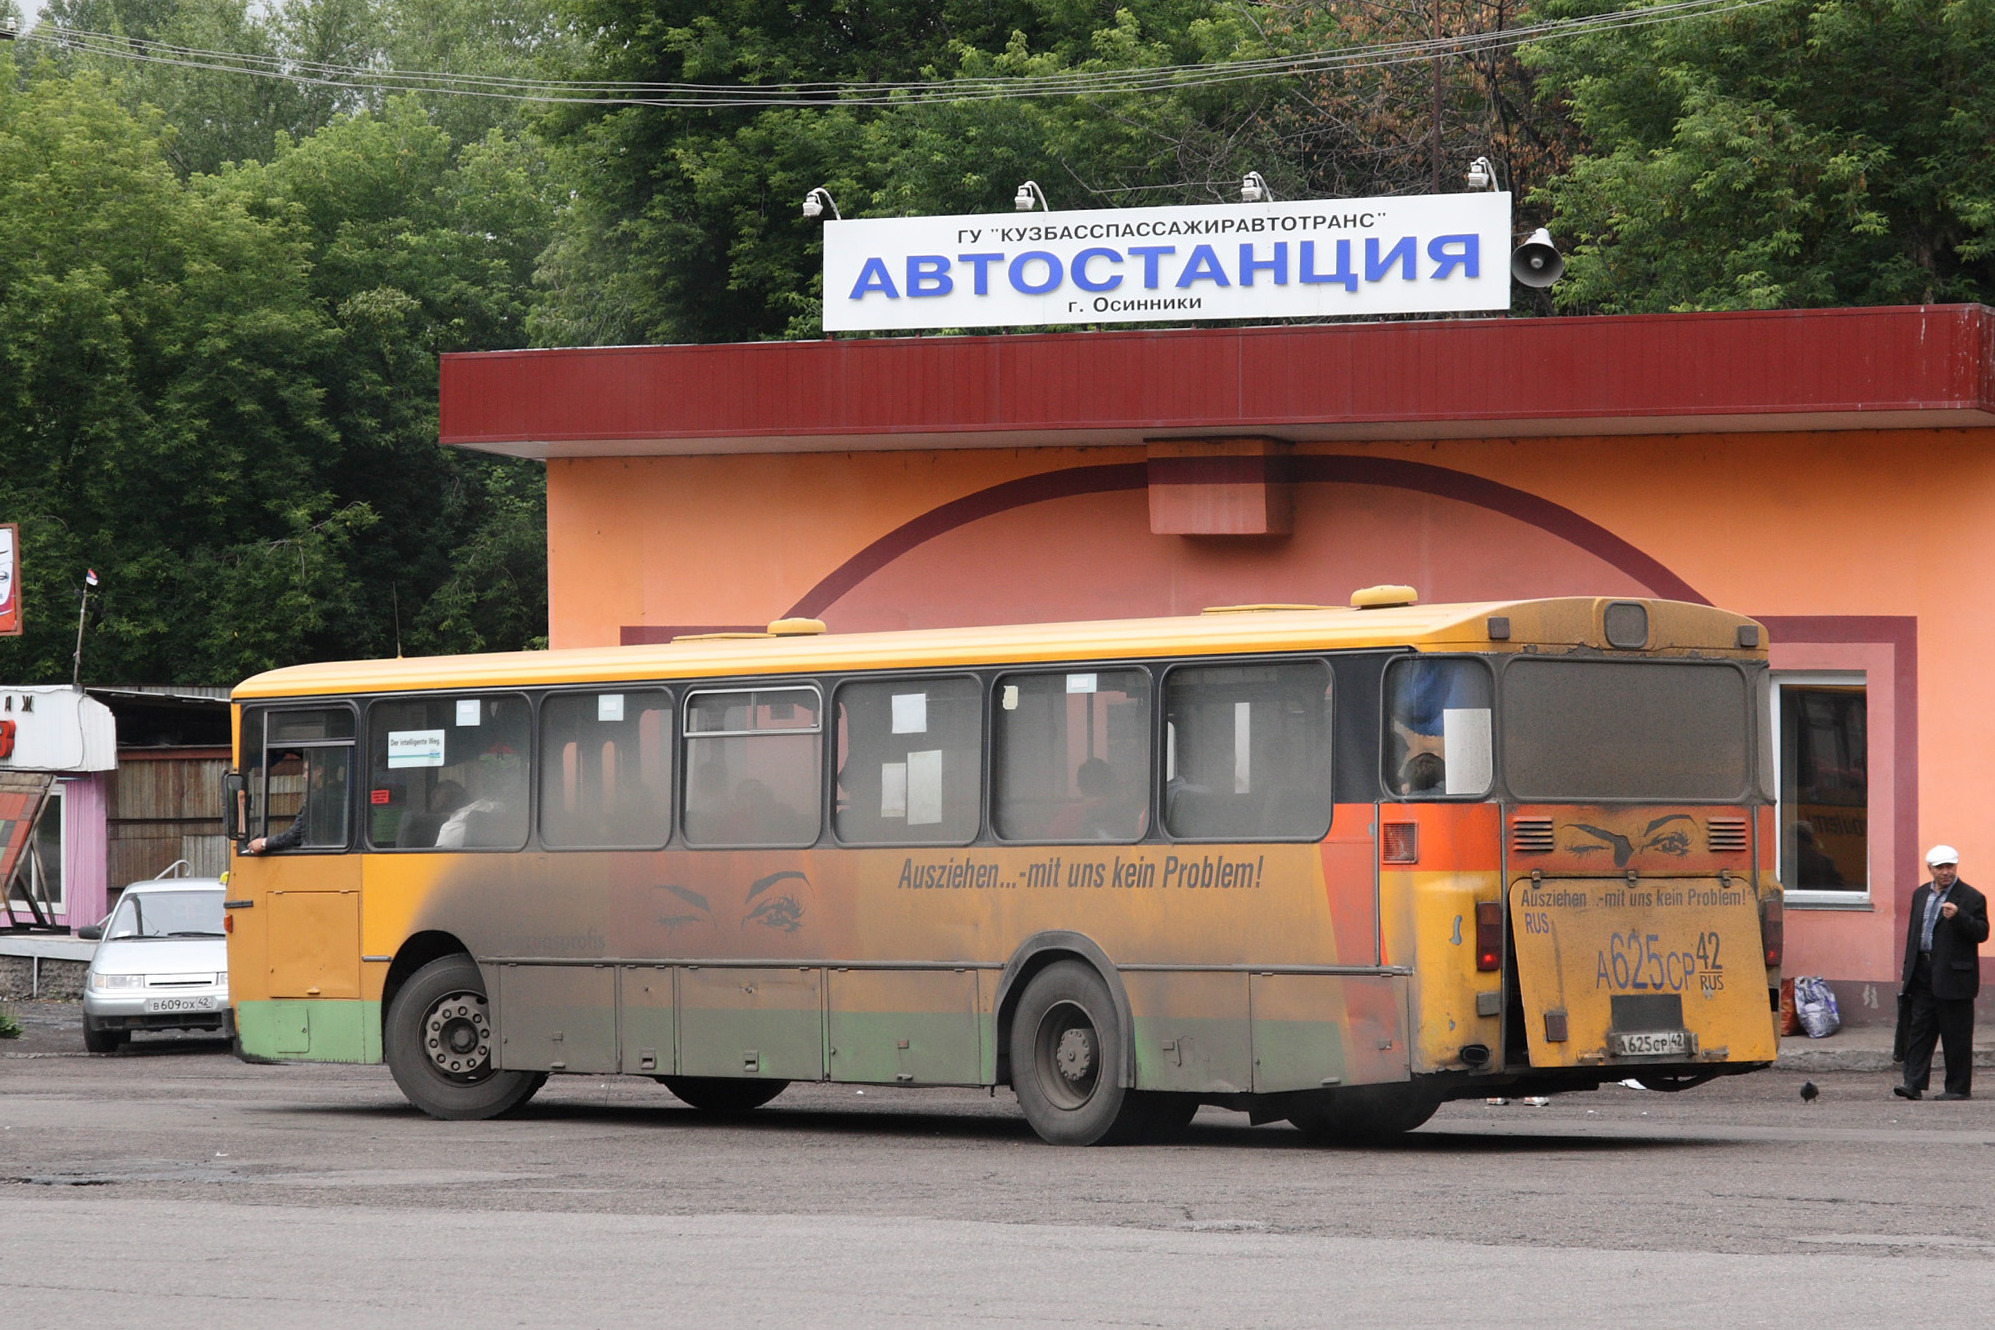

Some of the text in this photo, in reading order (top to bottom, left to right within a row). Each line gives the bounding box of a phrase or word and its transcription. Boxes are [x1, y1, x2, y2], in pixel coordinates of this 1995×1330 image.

[957, 212, 1387, 244] ГУ "КУЗБАССПАССАЖИРАВТОТРАНС"
[848, 233, 1480, 300] АВТОСТАНЦИЯ
[1068, 297, 1202, 314] г. Осинники
[1067, 862, 1106, 889] uns
[1112, 855, 1156, 889] kein
[1162, 855, 1264, 889] Problem!
[1629, 892, 1652, 908] uns
[1656, 889, 1683, 907] kein
[1687, 888, 1747, 907] Problem!
[1524, 912, 1550, 935] RUS
[1696, 931, 1724, 971] 42
[1699, 974, 1725, 992] RUS
[1670, 1033, 1683, 1047] 42
